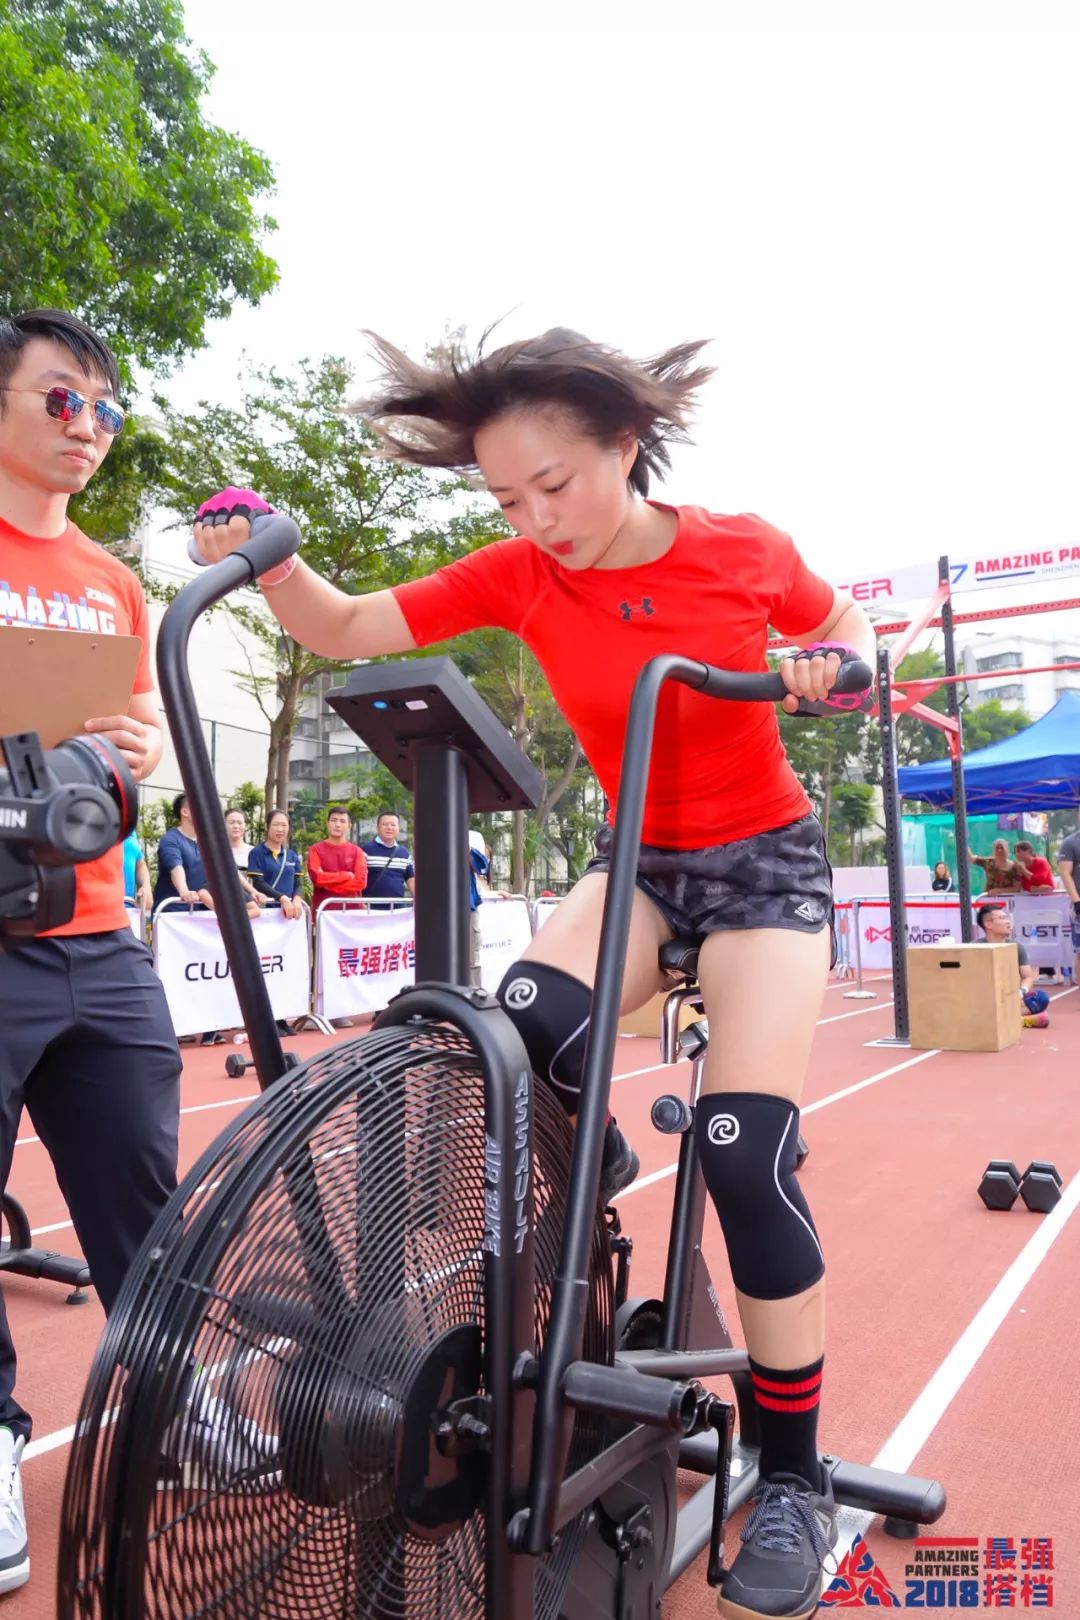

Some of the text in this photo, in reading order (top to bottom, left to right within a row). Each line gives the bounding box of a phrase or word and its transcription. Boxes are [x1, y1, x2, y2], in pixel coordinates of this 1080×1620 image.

[975, 551, 1053, 574] AMAZING
[184, 954, 284, 982] CLUER
[514, 1071, 529, 1254] ASSAULT
